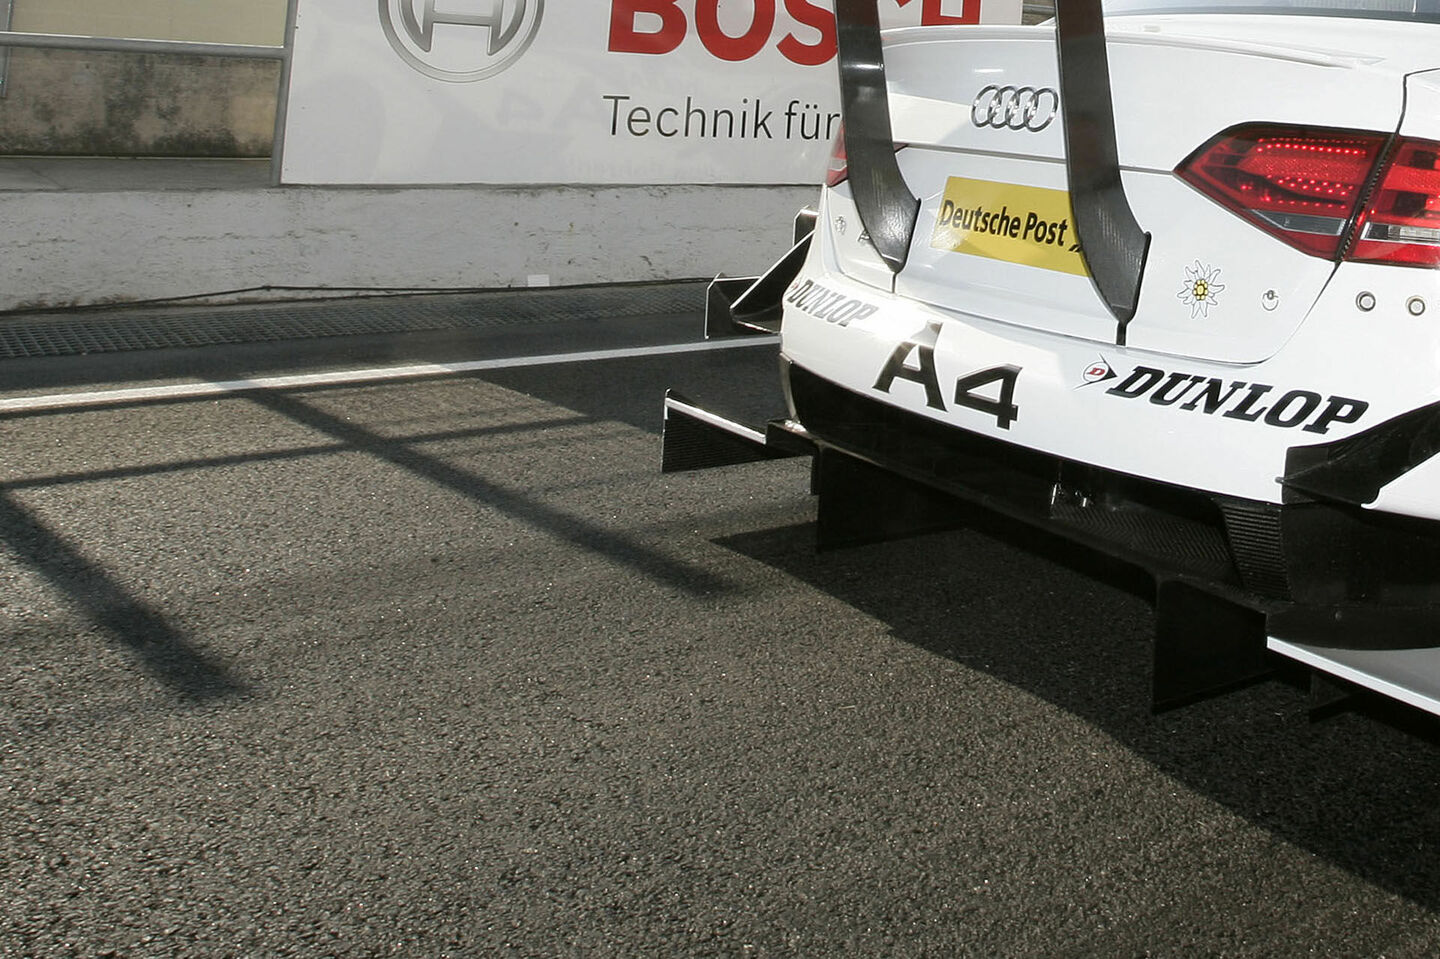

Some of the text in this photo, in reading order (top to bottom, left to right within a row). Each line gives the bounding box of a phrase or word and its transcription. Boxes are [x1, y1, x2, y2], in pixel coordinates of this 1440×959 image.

[602, 94, 840, 140] Technik für
[940, 200, 1068, 246] Deutsche Post
[787, 279, 879, 327] DUNLOP
[872, 321, 1024, 431] A4
[1105, 365, 1370, 436] DUNLOP
